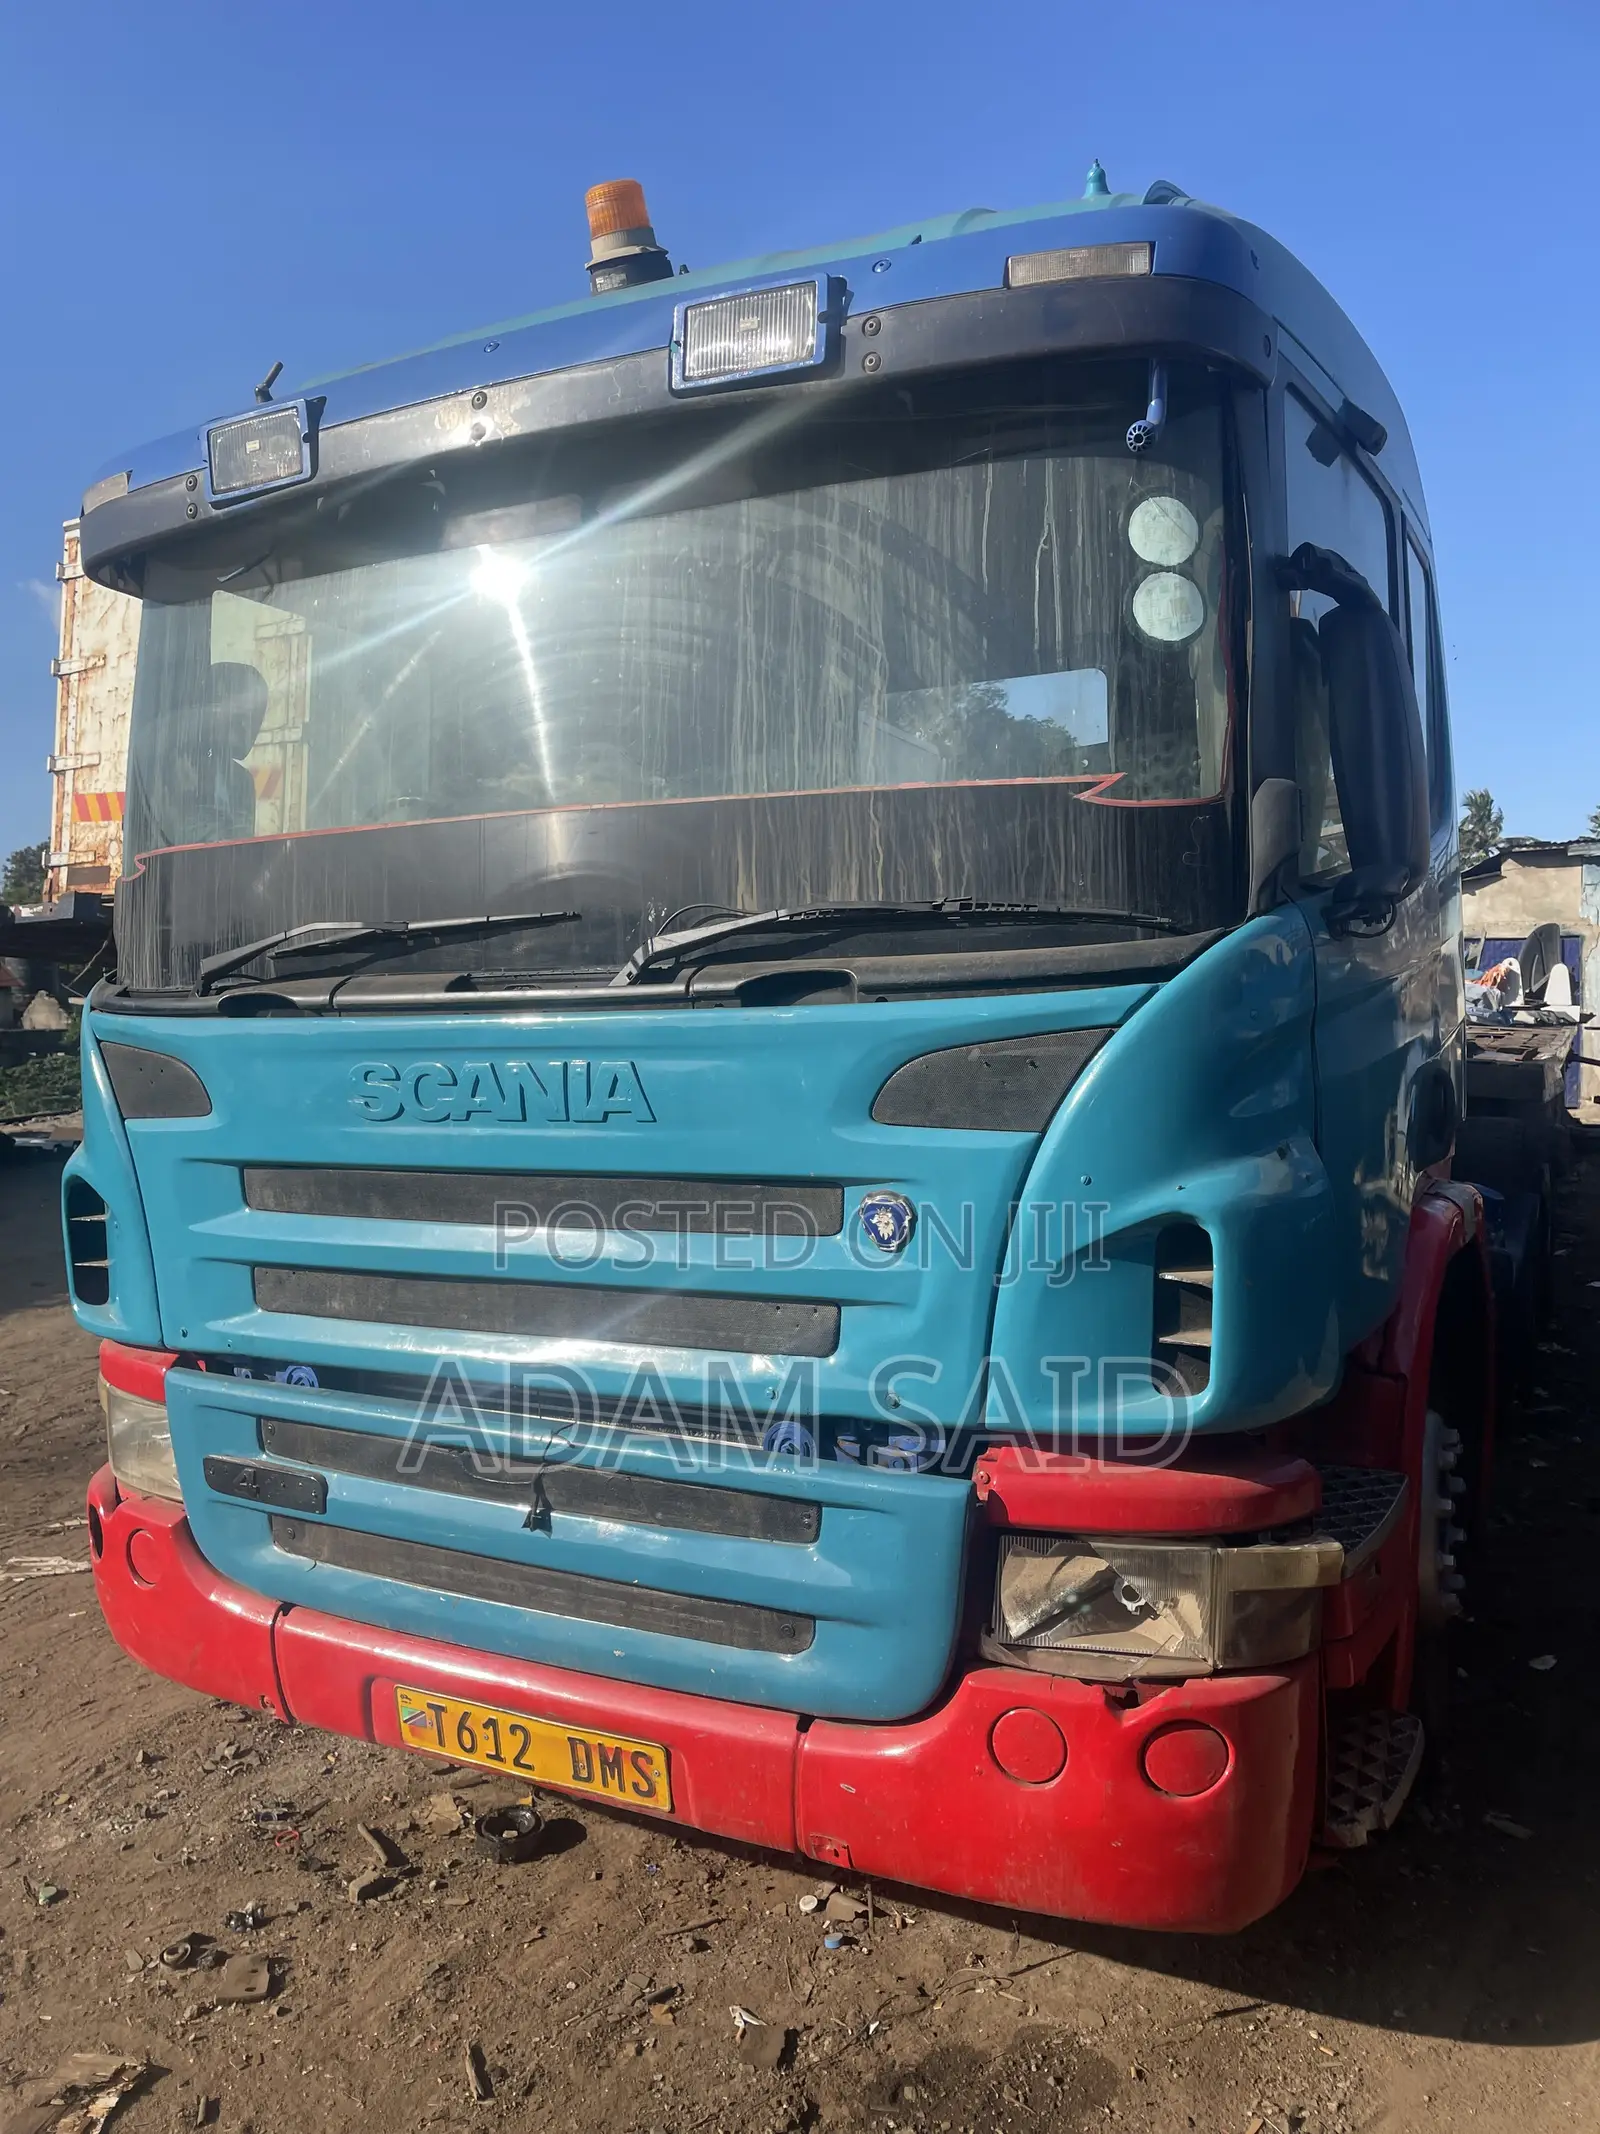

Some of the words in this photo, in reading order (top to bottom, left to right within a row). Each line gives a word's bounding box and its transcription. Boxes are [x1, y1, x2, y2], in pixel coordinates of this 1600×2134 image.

[347, 1059, 658, 1124] SCANIA
[426, 1702, 535, 1772] T612
[567, 1735, 657, 1798] DMS
